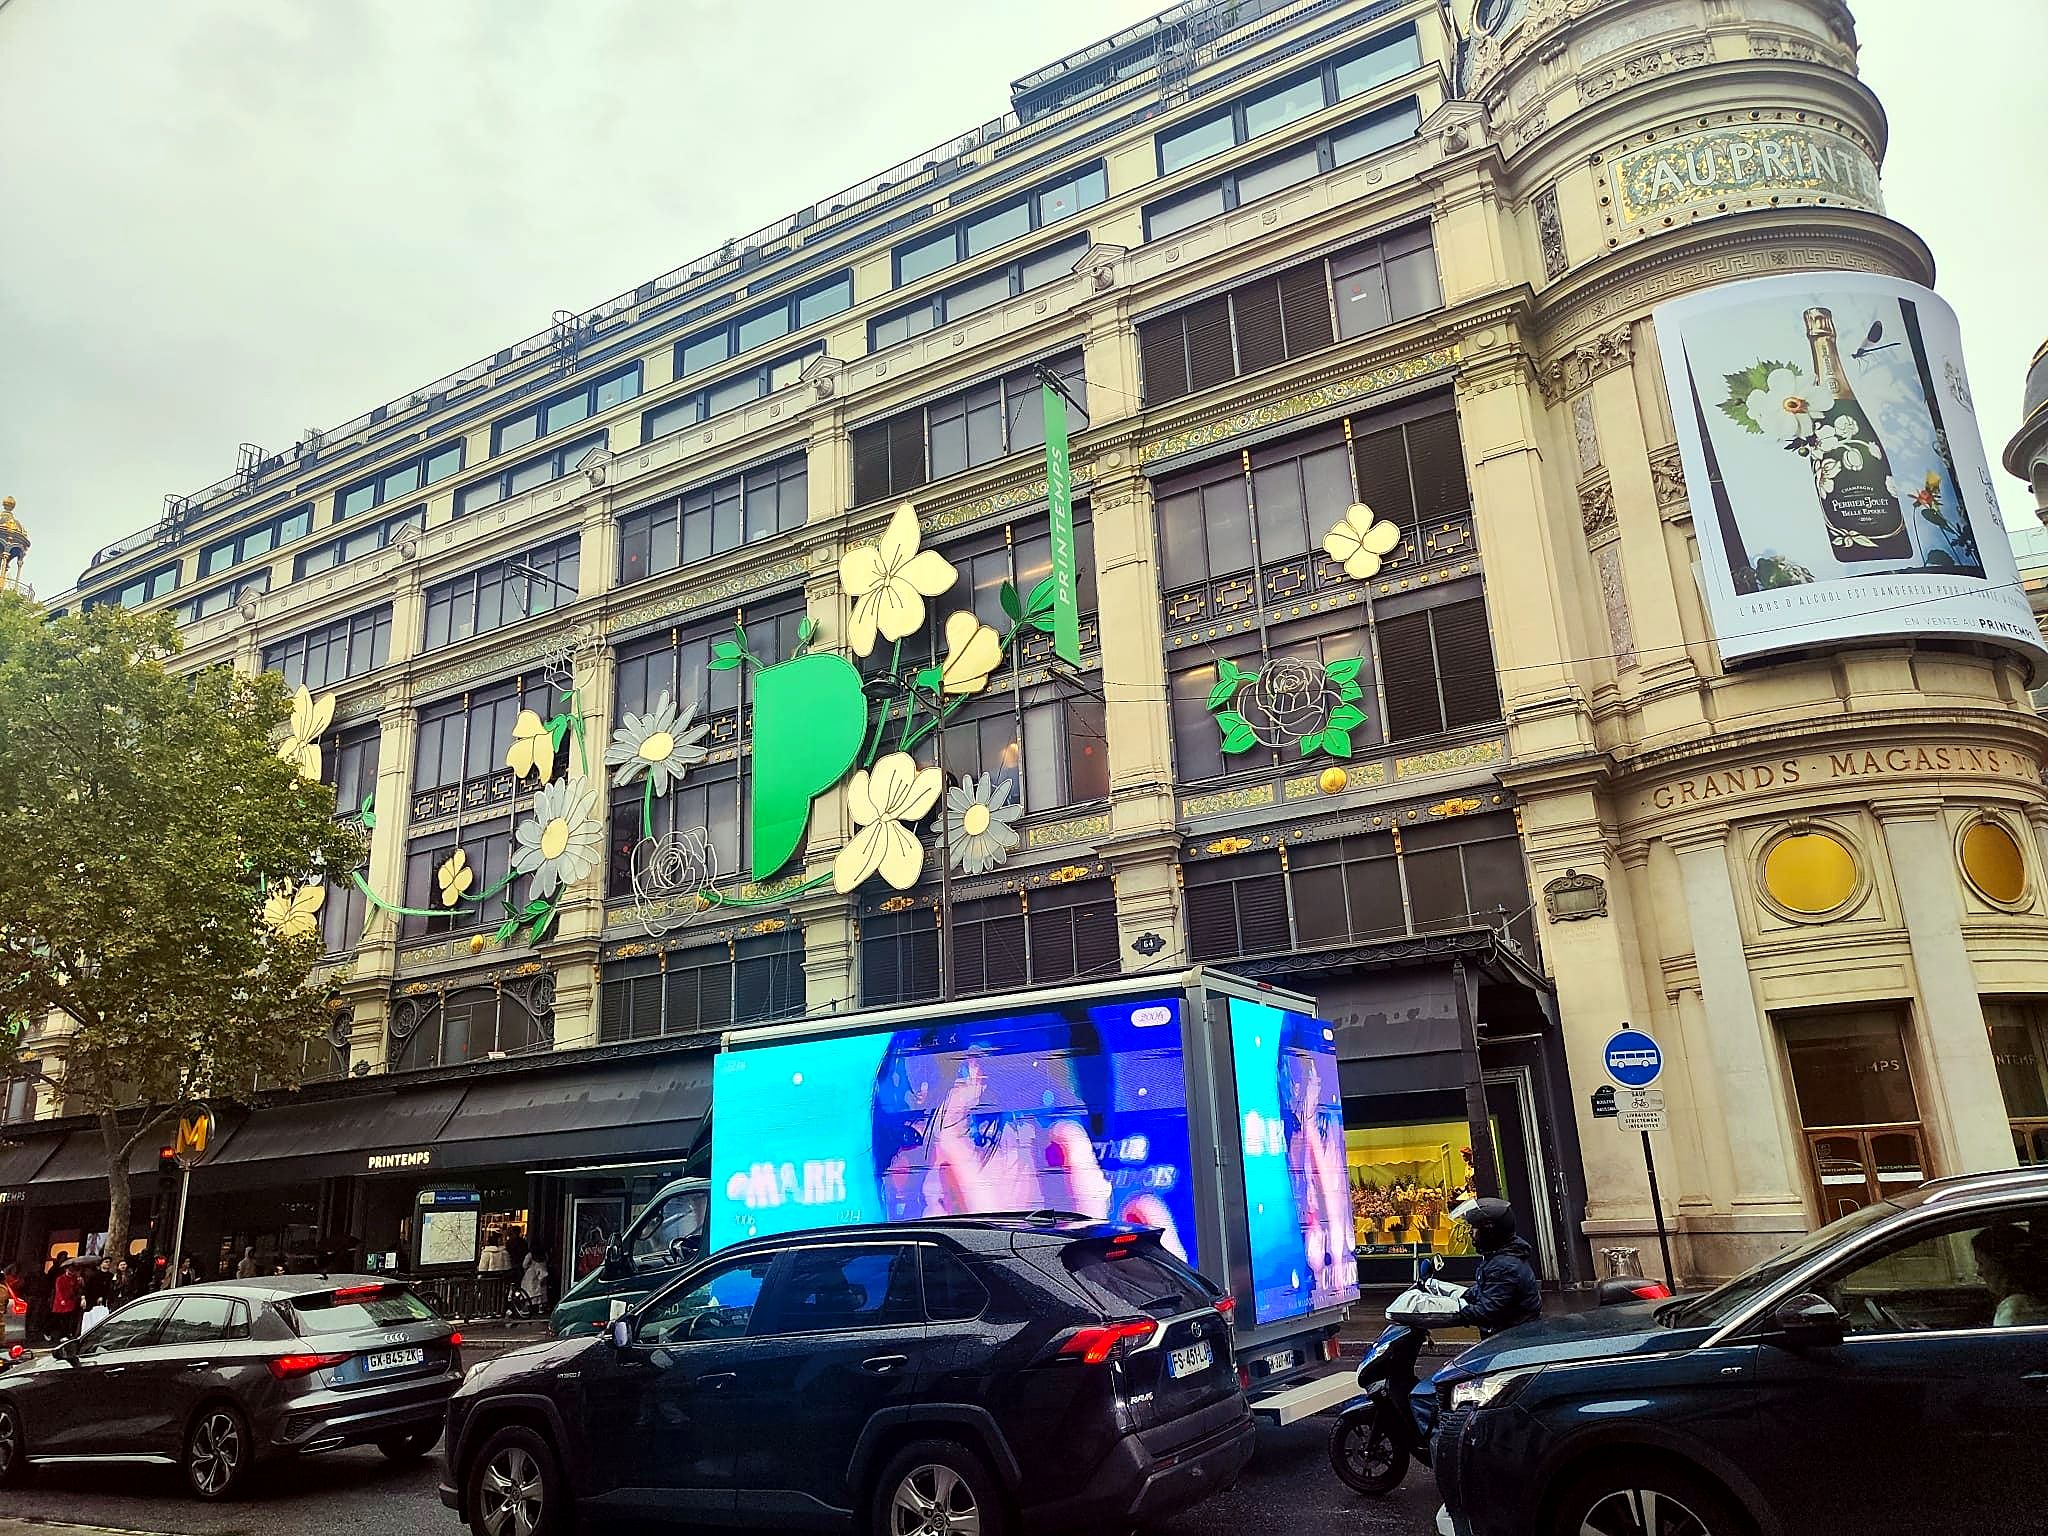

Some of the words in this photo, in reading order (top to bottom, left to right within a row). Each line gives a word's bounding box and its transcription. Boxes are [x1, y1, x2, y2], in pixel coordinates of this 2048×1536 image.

[1650, 146, 1717, 201] AU
[1052, 445, 1071, 606] PRINTEMPS
[1904, 617, 1920, 626] EN
[1926, 617, 1961, 626] VENTE
[1963, 618, 1976, 627] AU
[1978, 618, 2037, 641] PRINTEMPS
[1652, 759, 1801, 810] GRANDS
[1829, 748, 2001, 778] MAGASINS
[368, 1151, 431, 1169] PRINTEMPS
[370, 1350, 418, 1368] GX-845-ZK
[1720, 1366, 1743, 1375] GT
